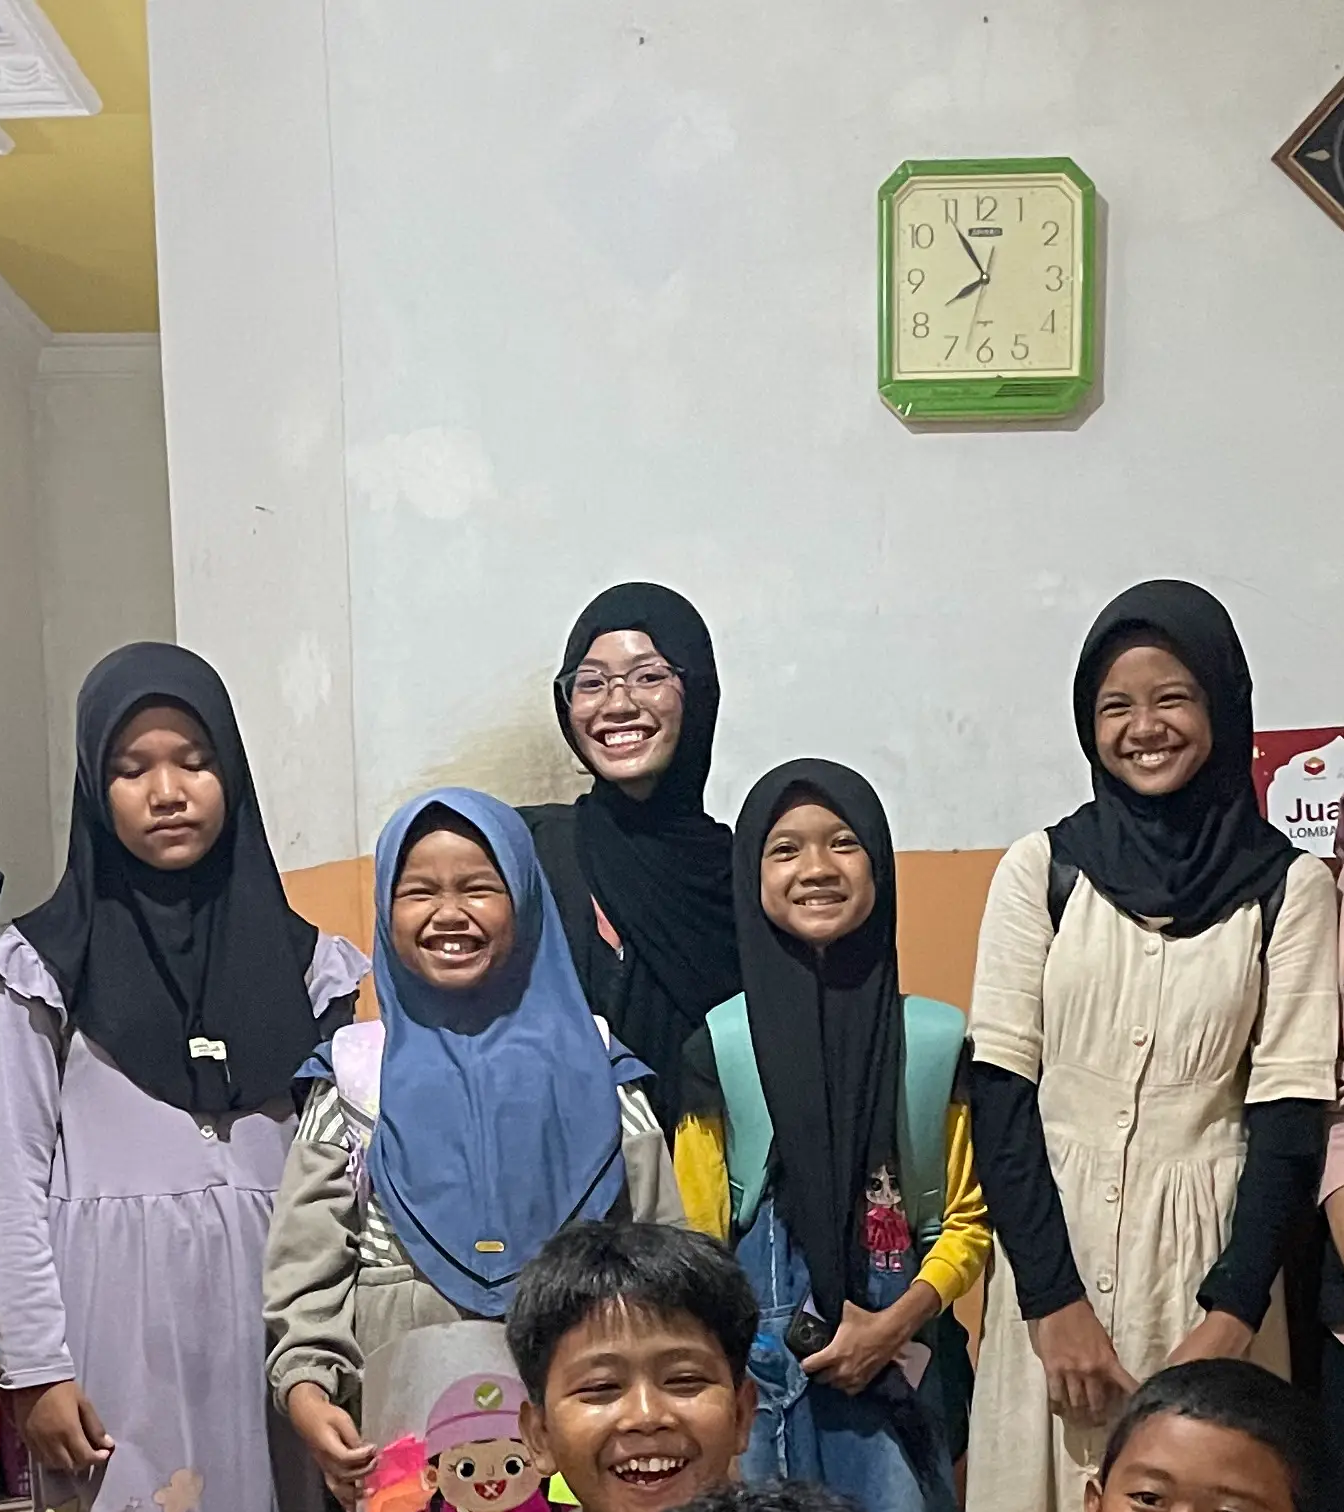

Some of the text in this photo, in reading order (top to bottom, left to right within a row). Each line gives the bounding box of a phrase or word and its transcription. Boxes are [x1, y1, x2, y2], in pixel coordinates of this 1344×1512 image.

[976, 196, 998, 221] 12
[1015, 197, 1023, 221] 1
[909, 223, 934, 249] 10
[1042, 221, 1059, 247] 2
[907, 268, 925, 295] 9
[1046, 266, 1063, 292] 3
[912, 312, 930, 338] 8
[1040, 309, 1056, 334] 4
[944, 335, 959, 361] 7
[976, 337, 994, 363] 6
[1010, 334, 1029, 360] 5
